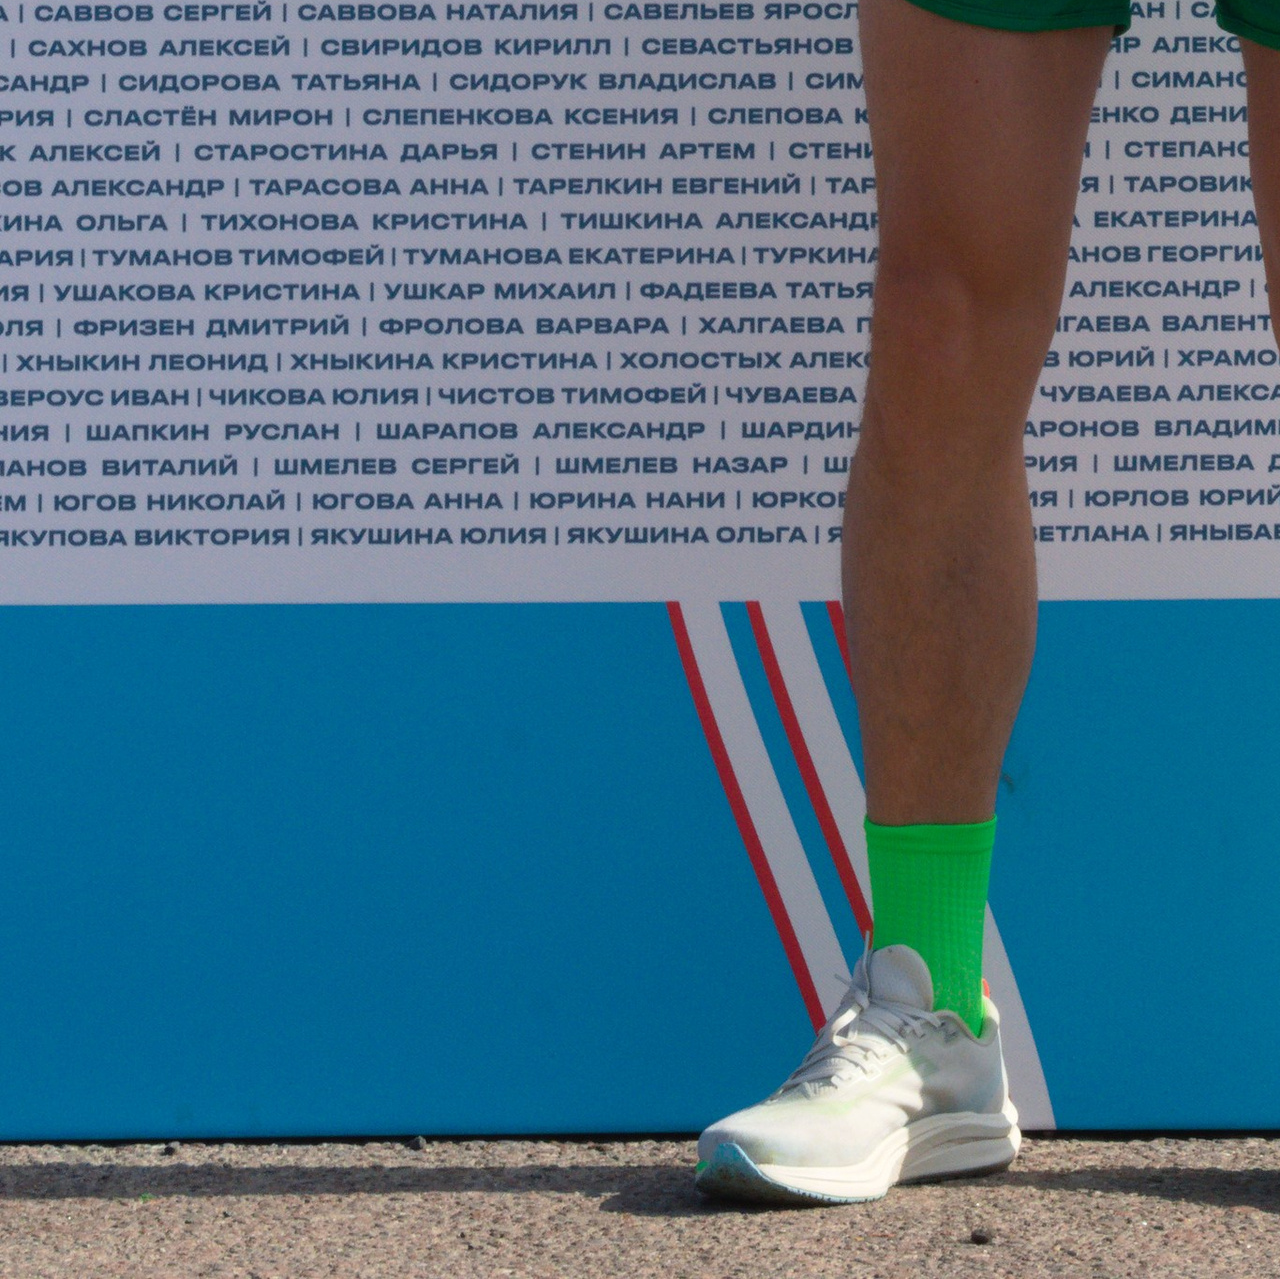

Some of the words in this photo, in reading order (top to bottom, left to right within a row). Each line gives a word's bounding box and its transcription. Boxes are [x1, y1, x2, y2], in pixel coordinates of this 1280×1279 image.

[298, 4, 436, 21] САВВОВА
[447, 4, 577, 20] НАТАЛИЯ
[119, 75, 280, 93] СИДОРОВА
[292, 74, 420, 90] ТАТЬЯНА
[195, 144, 387, 161] СТАРОСТИНА
[401, 144, 497, 162] ДАРЬЯ
[201, 214, 358, 230] ТИХОНОВА
[373, 213, 527, 230] КРИСТИНА
[54, 285, 195, 301] УШАКОВА
[205, 284, 360, 300] КРИСТИНА
[17, 355, 139, 371] ХНЫКИН
[149, 354, 268, 372] ЛЕОНИД
[87, 425, 209, 441] ШАПКИН
[225, 424, 339, 440] РУСЛАН
[313, 493, 414, 510] ЮГОВА
[424, 493, 503, 509] АННА
[311, 528, 453, 545] ЯКУШИНА
[461, 528, 546, 544] ЮЛИЯ
